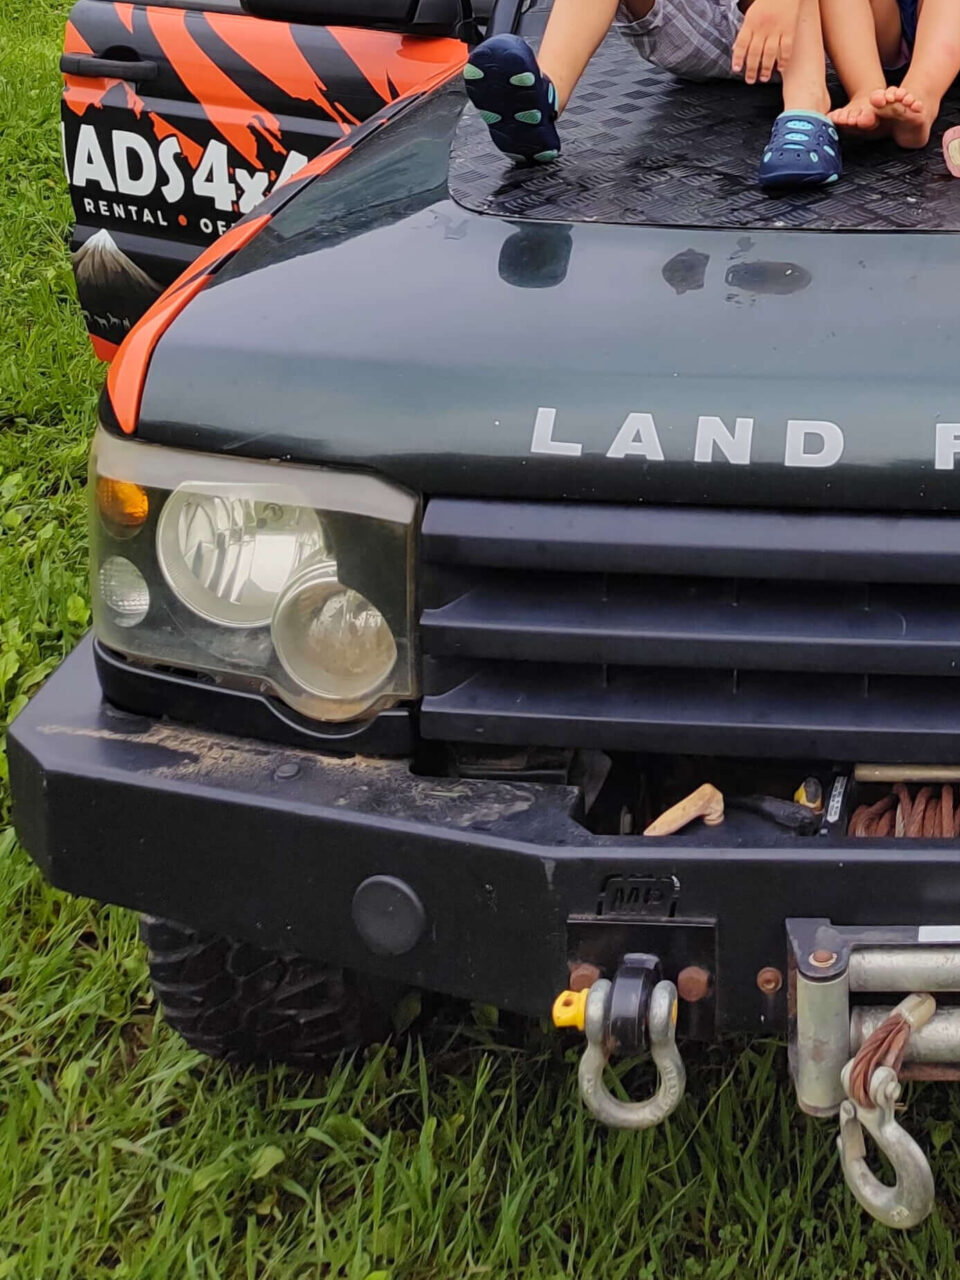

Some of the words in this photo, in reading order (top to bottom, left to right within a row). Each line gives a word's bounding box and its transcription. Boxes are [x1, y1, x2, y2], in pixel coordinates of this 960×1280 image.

[83, 197, 168, 227] RENTAL
[200, 217, 237, 236] OF
[531, 407, 845, 468] LAND
